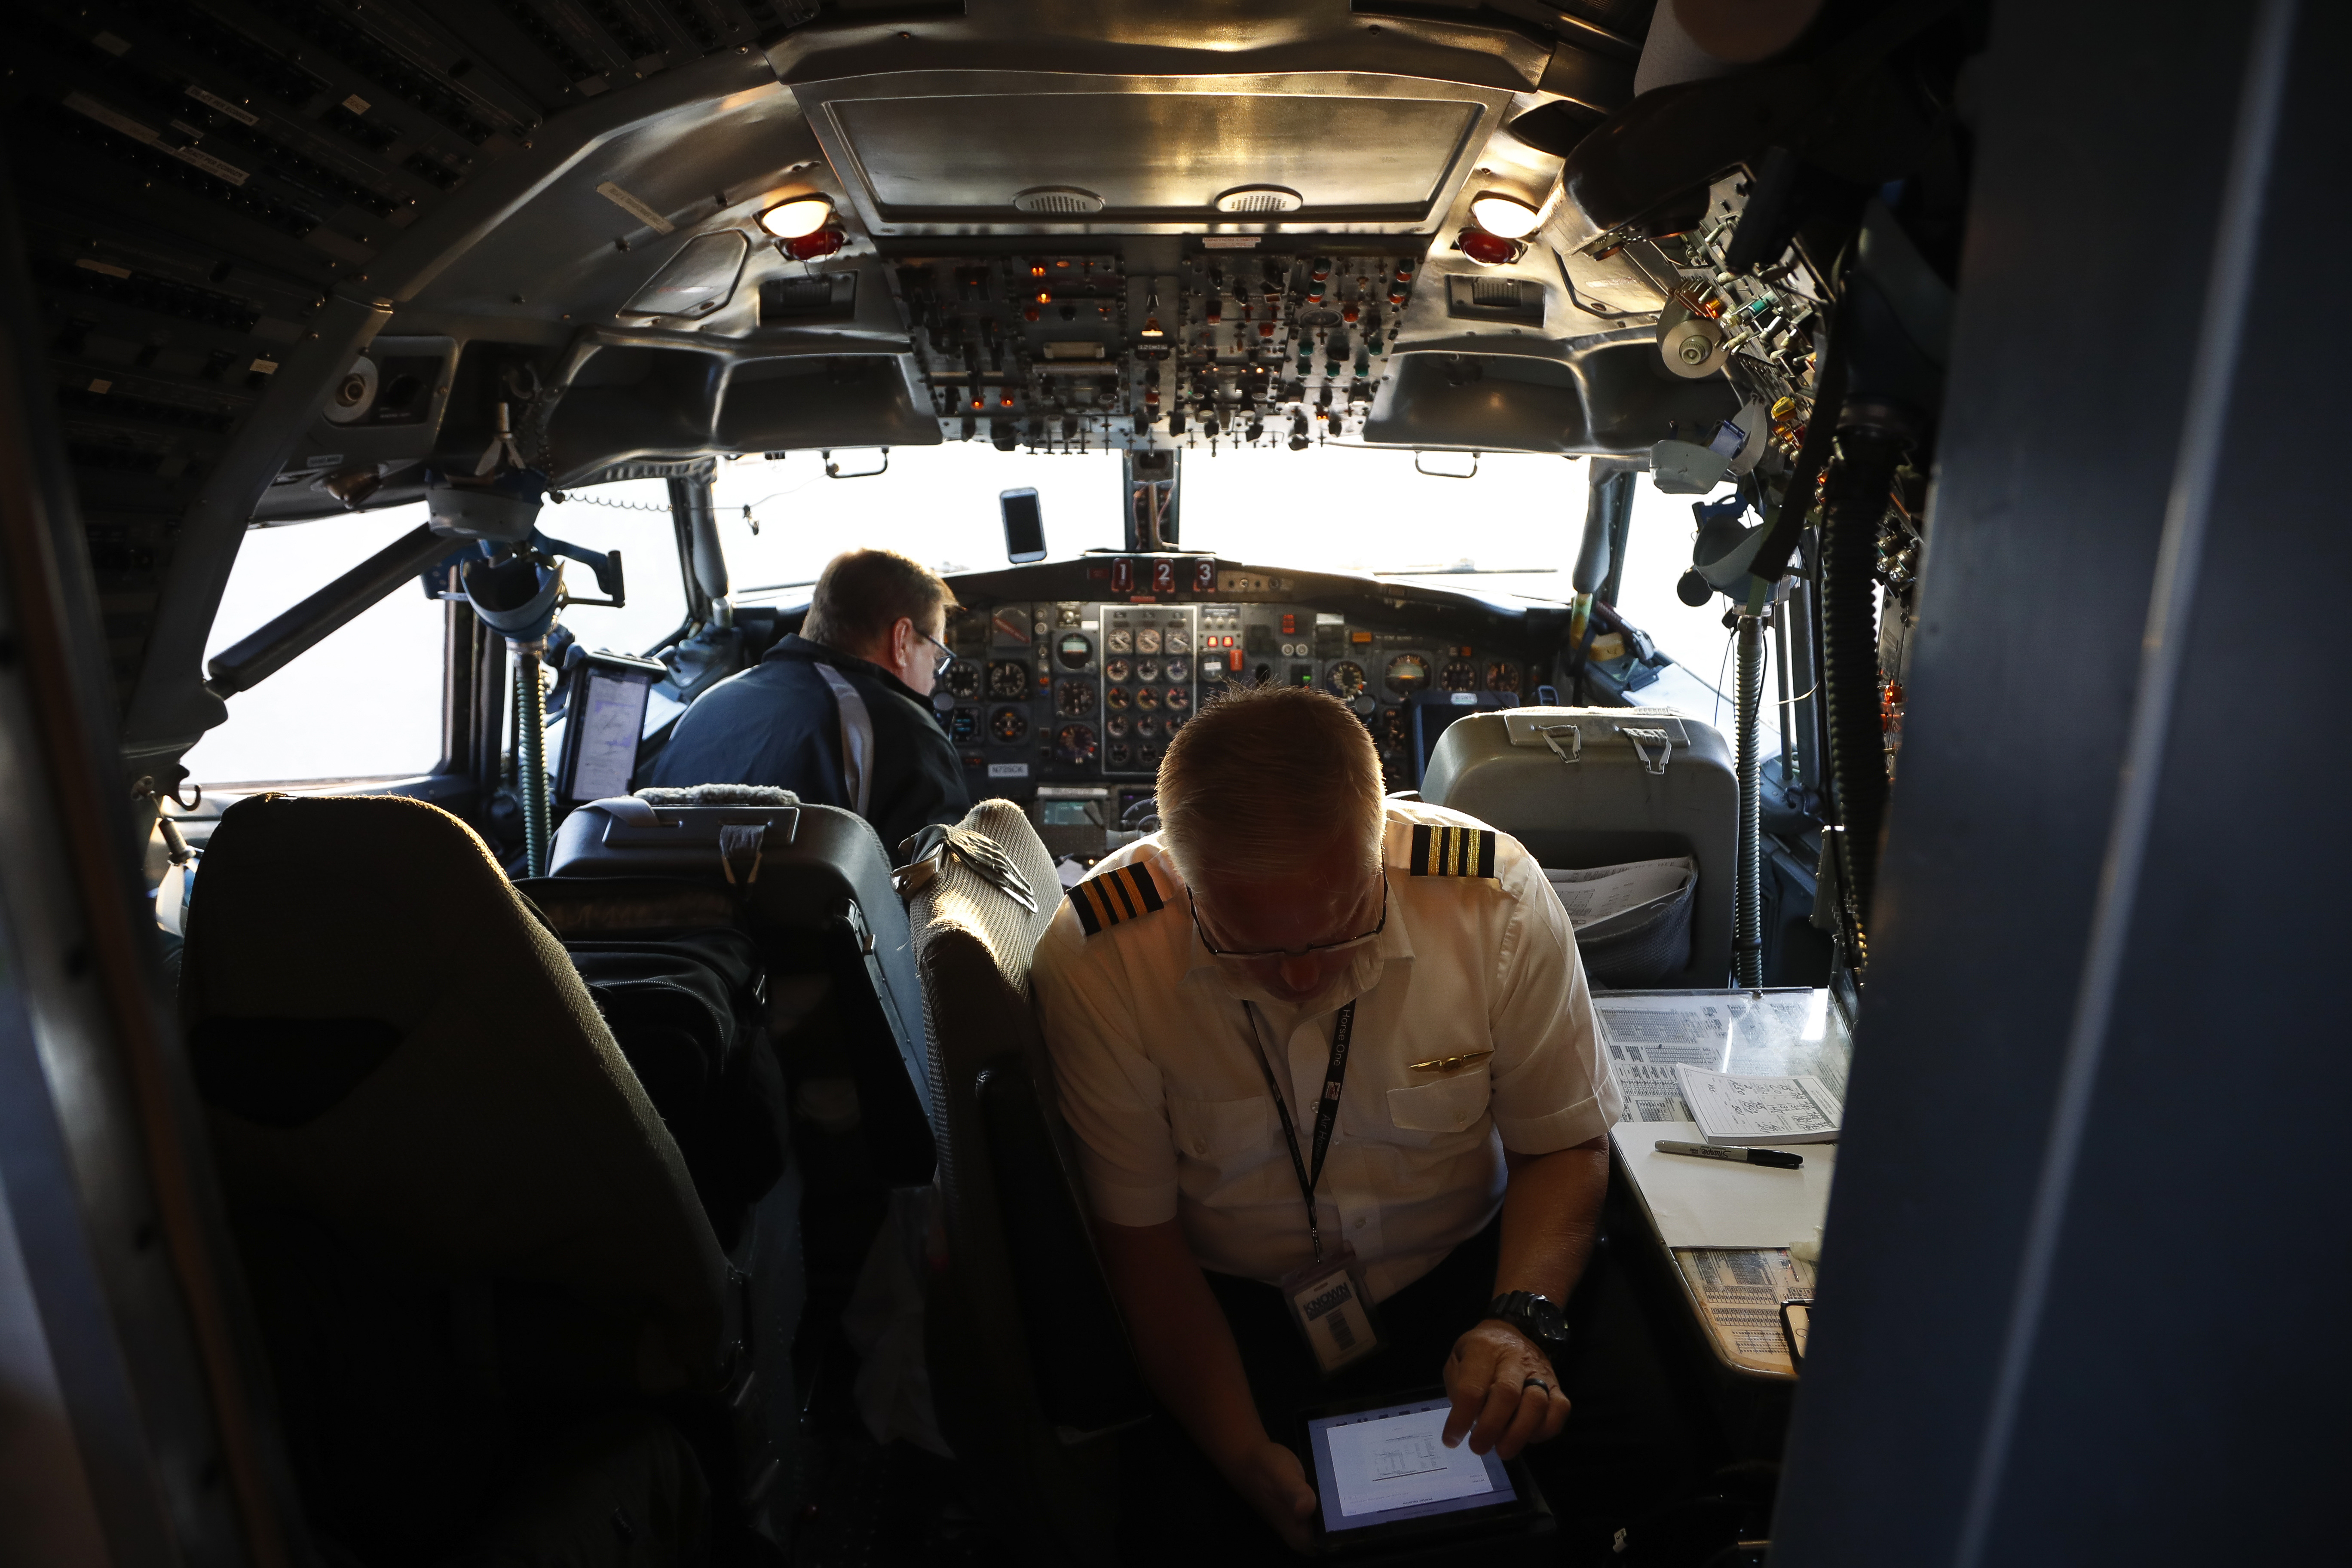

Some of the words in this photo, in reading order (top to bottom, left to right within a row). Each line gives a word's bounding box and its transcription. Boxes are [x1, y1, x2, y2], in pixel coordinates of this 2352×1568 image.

[1119, 564, 1127, 580] 1
[1158, 564, 1170, 580] 2
[1199, 564, 1211, 580] 3
[1338, 1010, 1351, 1040] Horse
[1334, 1044, 1344, 1066] One
[1320, 1114, 1331, 1129] Air
[1314, 1130, 1327, 1160] Horse
[1701, 1148, 1731, 1158] Sharpie
[1302, 1282, 1350, 1314] KNOWN
